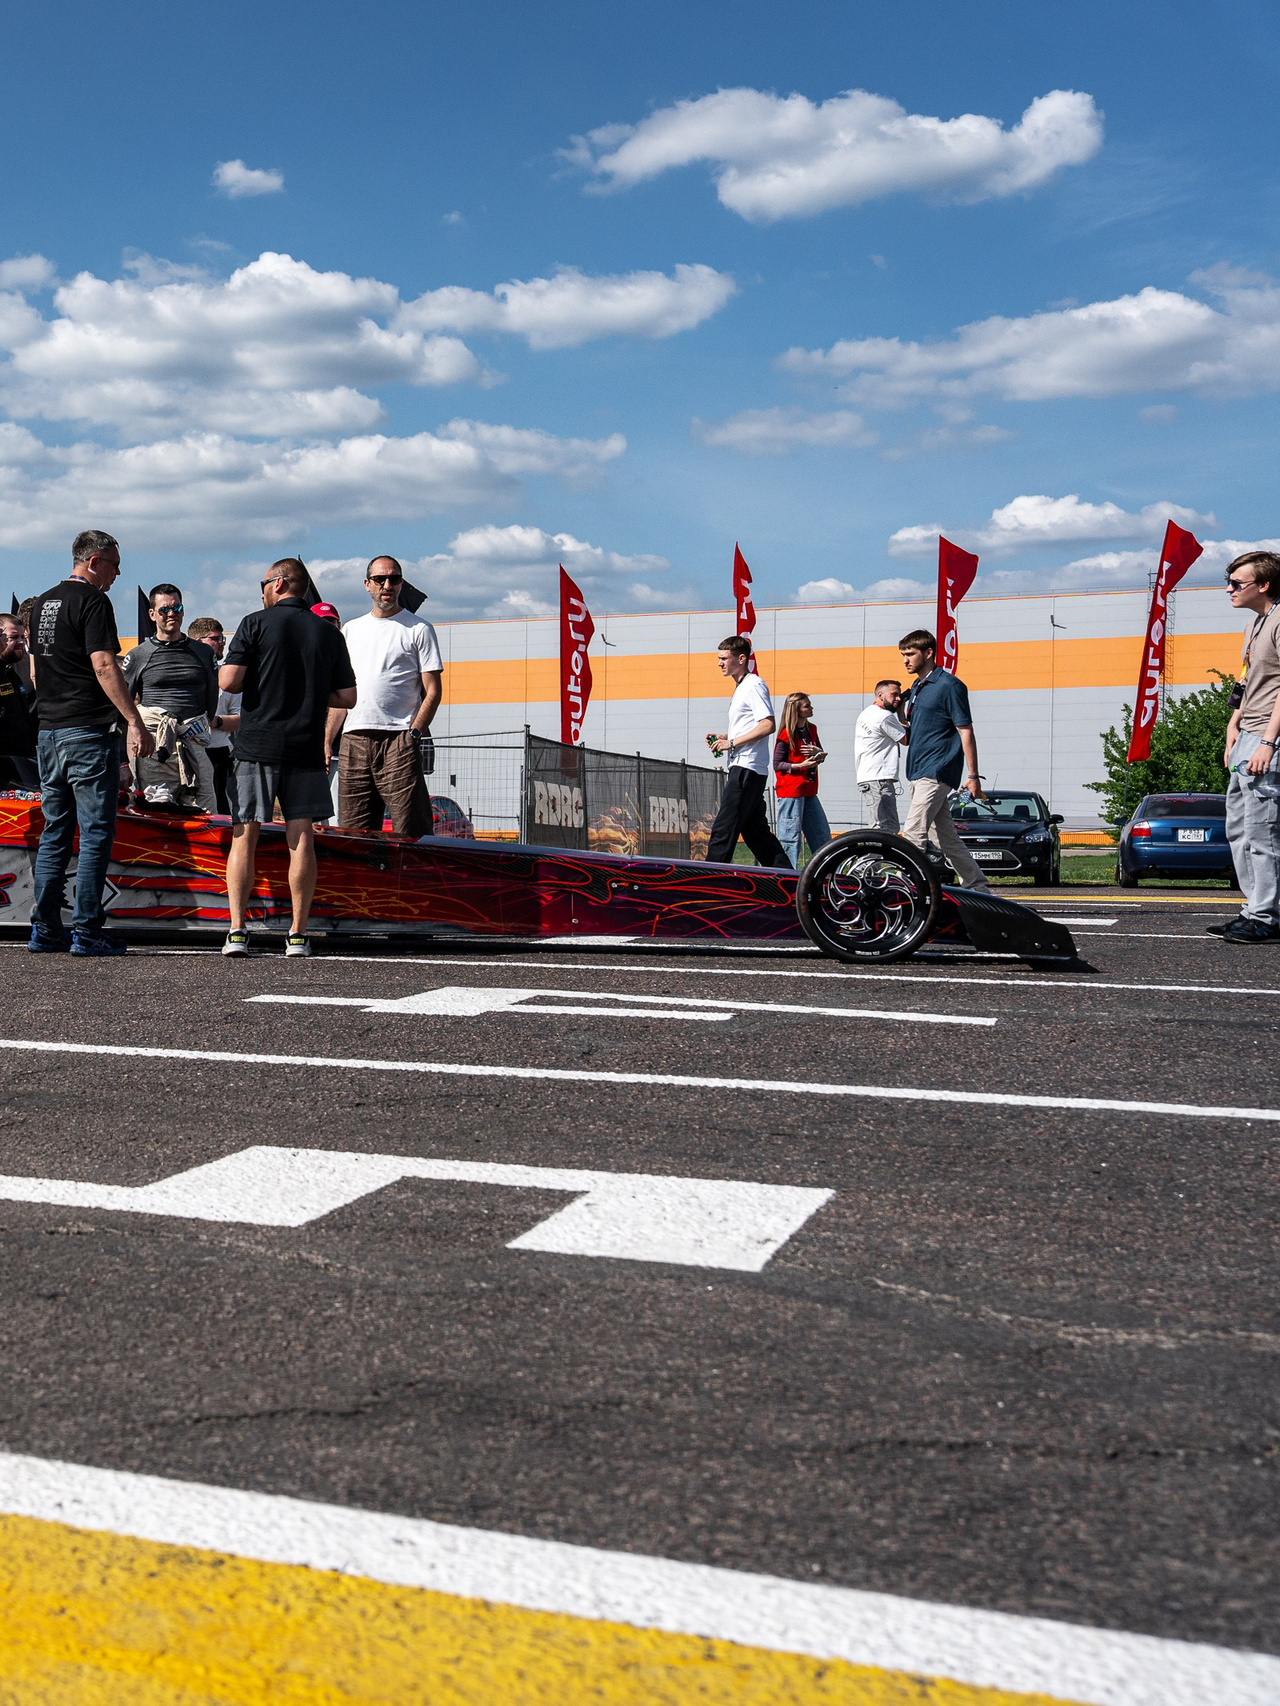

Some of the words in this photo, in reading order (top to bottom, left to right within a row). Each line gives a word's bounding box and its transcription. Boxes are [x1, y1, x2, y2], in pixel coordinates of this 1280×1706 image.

[567, 597, 587, 746] auto.ru
[534, 780, 584, 828] RDRC
[649, 796, 689, 833] RDRC
